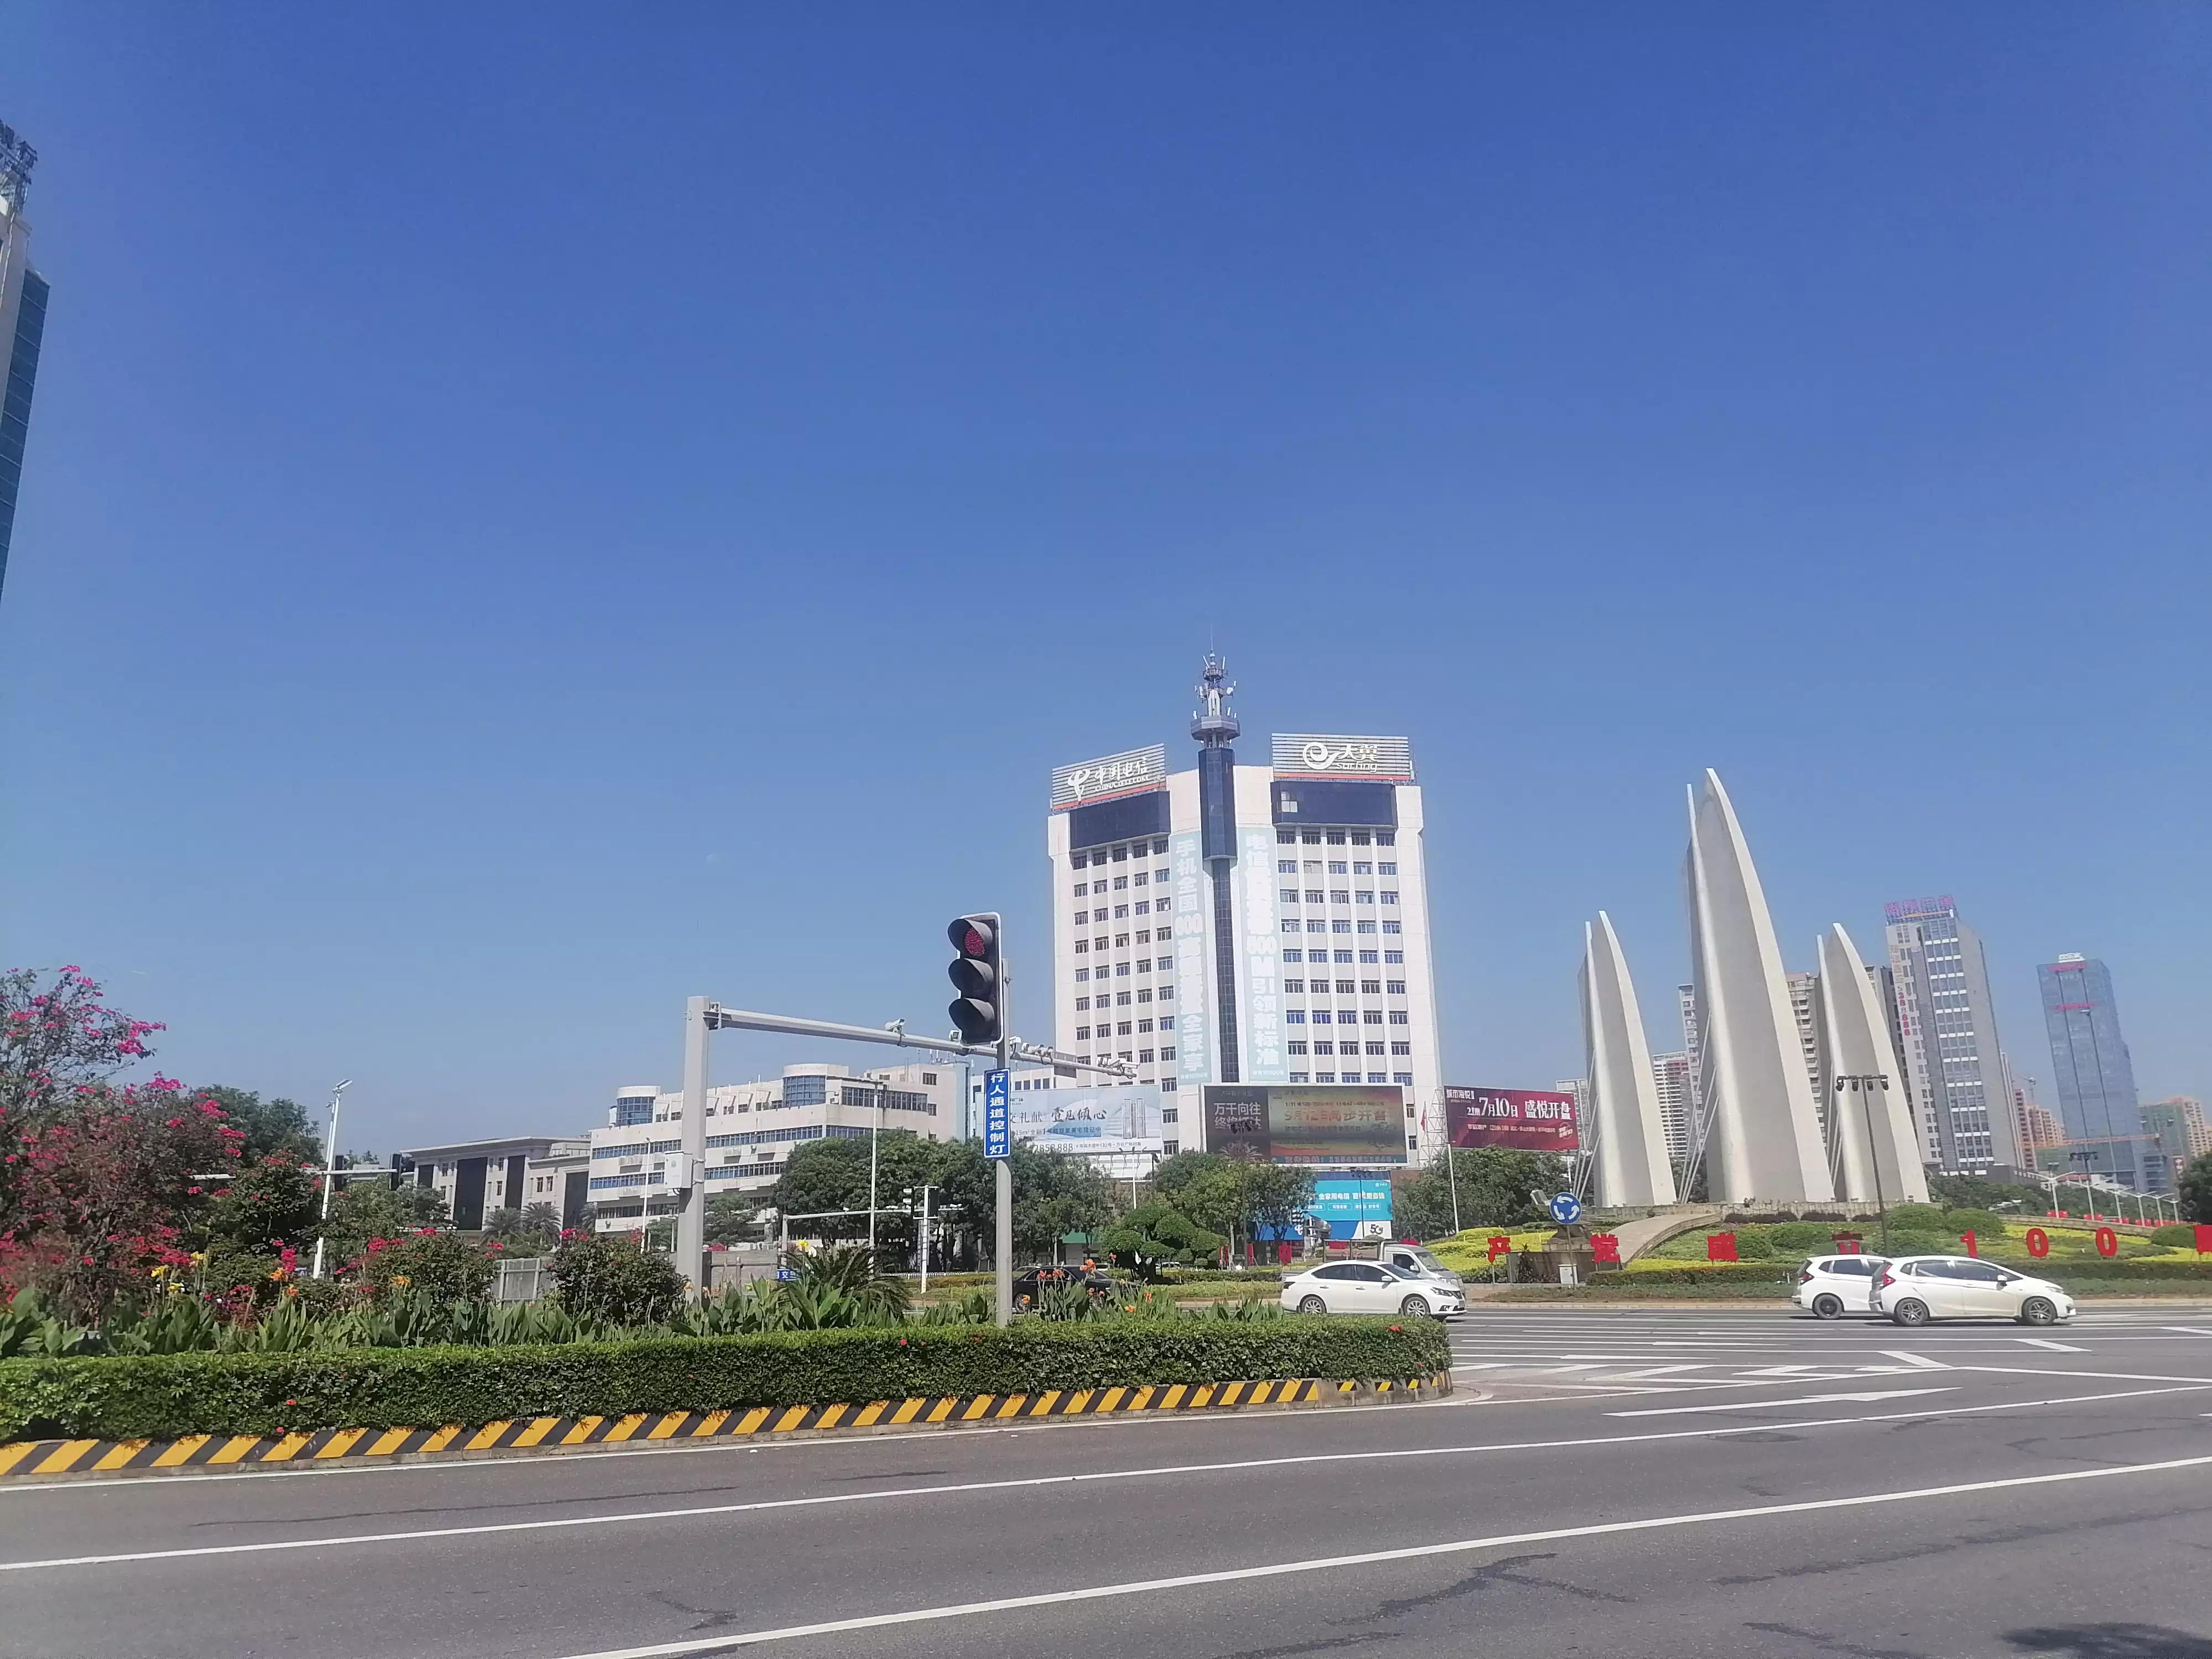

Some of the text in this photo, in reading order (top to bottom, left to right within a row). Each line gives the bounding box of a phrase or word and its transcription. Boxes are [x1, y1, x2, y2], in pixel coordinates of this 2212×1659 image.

[1337, 743, 1378, 761] 天翼
[1095, 757, 1147, 785] 中国电信
[1336, 761, 1378, 773] surfing
[990, 1073, 1006, 1155] 行人通道控制灯
[1214, 1102, 1261, 1115] 万千向往
[1525, 1099, 1572, 1120] 盛悦开盘
[1370, 1224, 1383, 1235] 5G
[1488, 1235, 1511, 1263] 产
